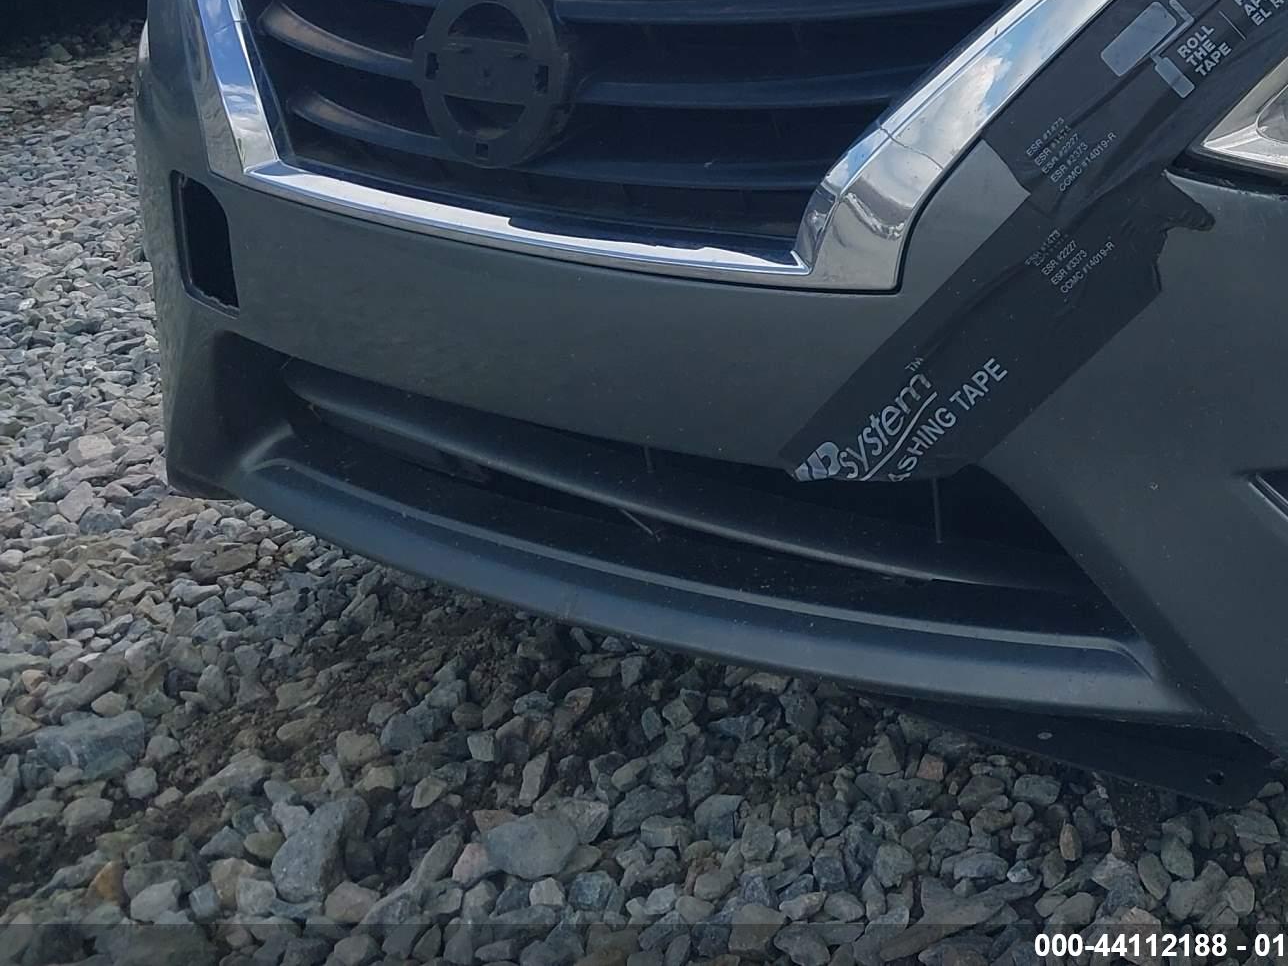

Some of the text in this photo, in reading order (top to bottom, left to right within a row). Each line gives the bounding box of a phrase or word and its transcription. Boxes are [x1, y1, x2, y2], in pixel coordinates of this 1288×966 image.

[1250, 10, 1272, 26] EL
[1176, 25, 1214, 59] ROLL
[1185, 39, 1216, 66] THE
[1195, 42, 1232, 76] TAPE
[1026, 138, 1043, 156] ESR
[1034, 147, 1052, 166] ESR
[1050, 164, 1068, 183] ESR
[1060, 165, 1082, 192] CCMC
[1041, 259, 1059, 275] ESR
[1050, 268, 1068, 285] ESR
[1060, 271, 1084, 293] CCMC
[949, 358, 1008, 411] TAPE
